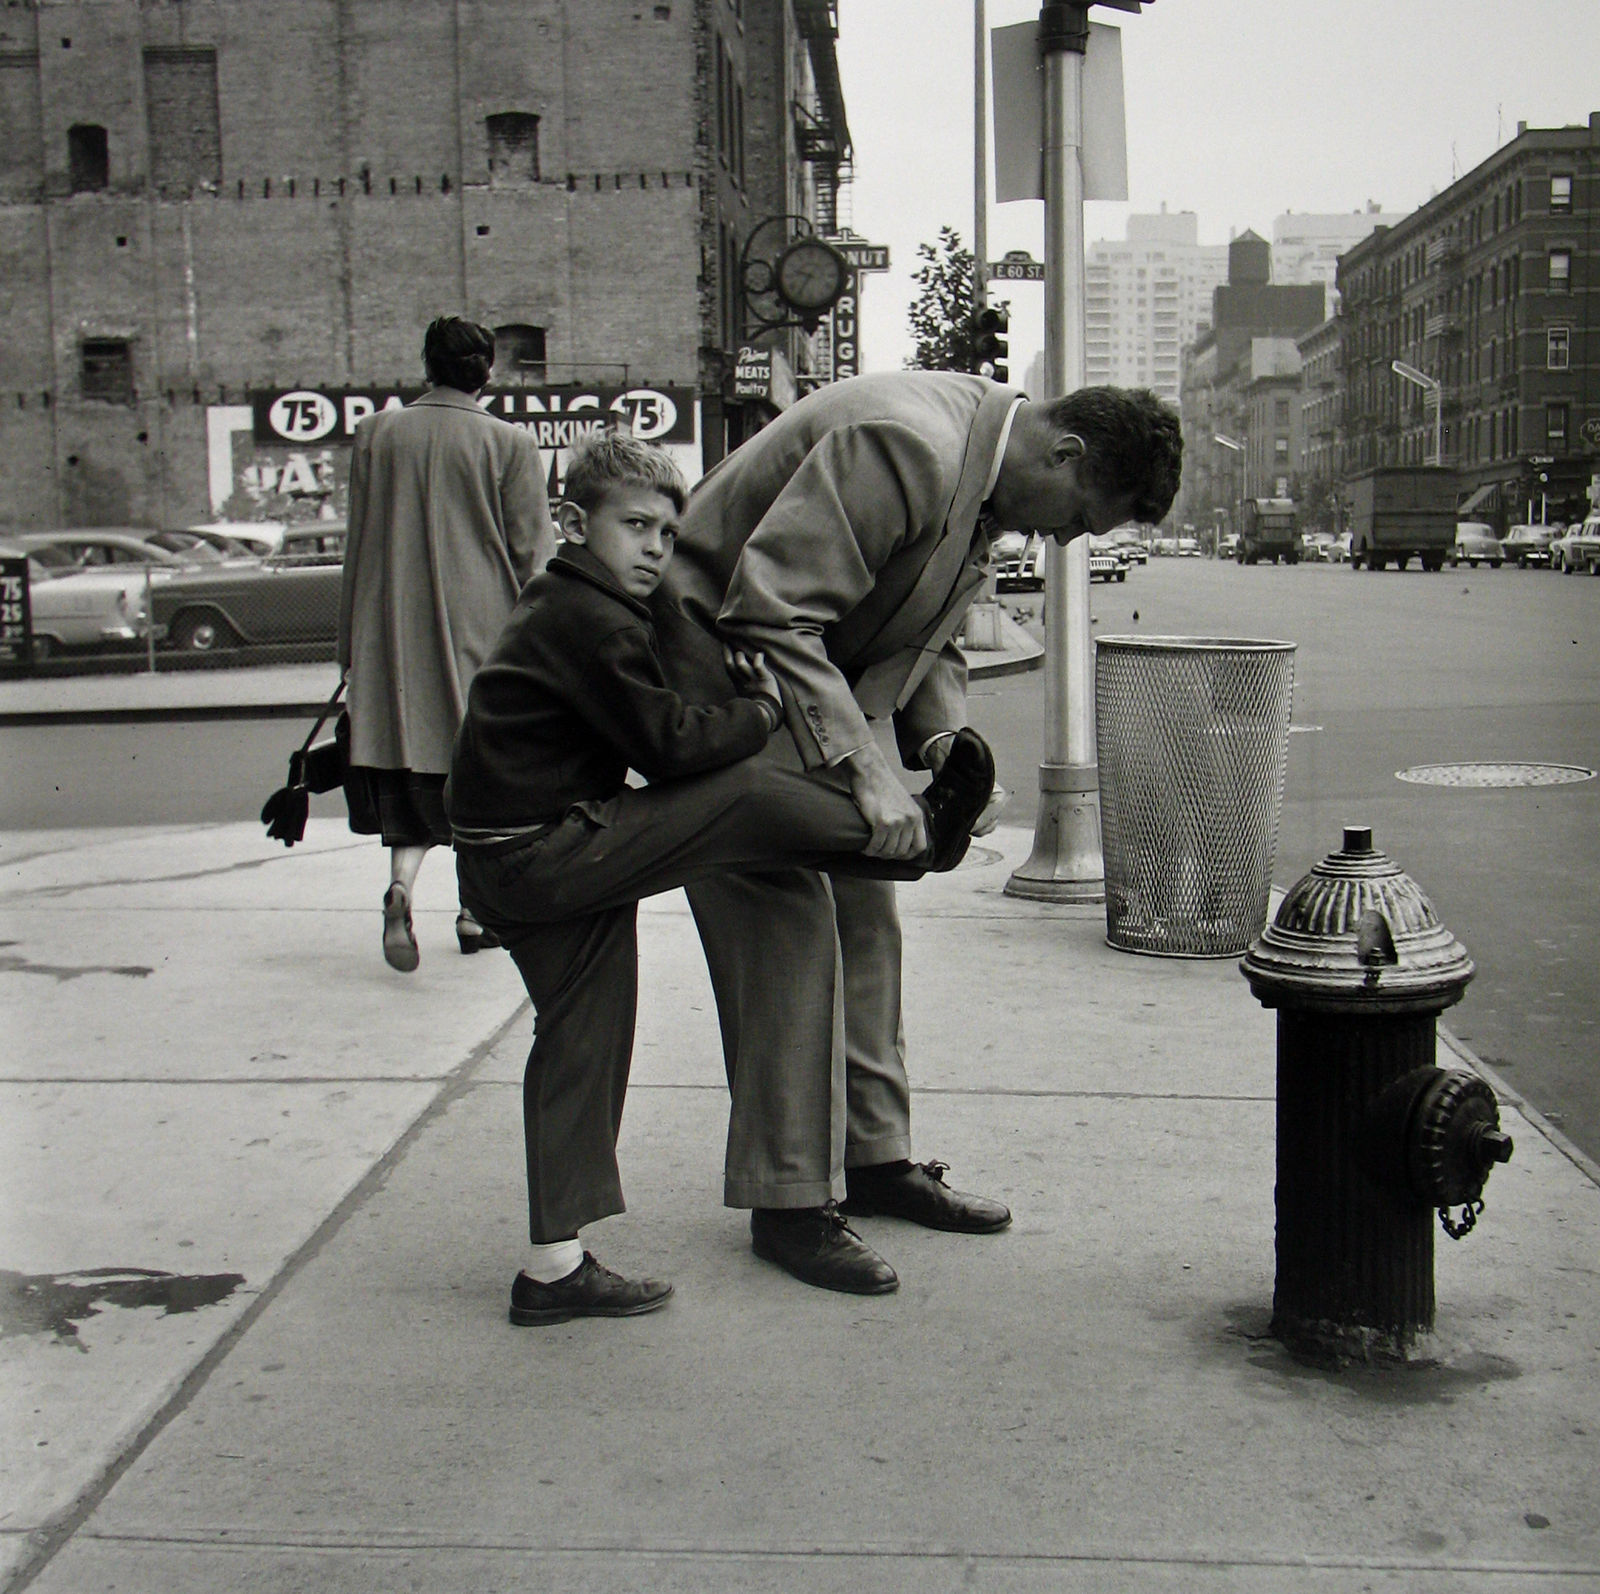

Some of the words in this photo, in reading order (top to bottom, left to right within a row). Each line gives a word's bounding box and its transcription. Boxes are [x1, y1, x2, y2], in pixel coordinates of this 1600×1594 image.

[1008, 265, 1024, 279] 60
[735, 366, 770, 379] MEATS
[282, 400, 320, 432] 75
[621, 398, 659, 432] 75
[1, 603, 22, 622] 25
